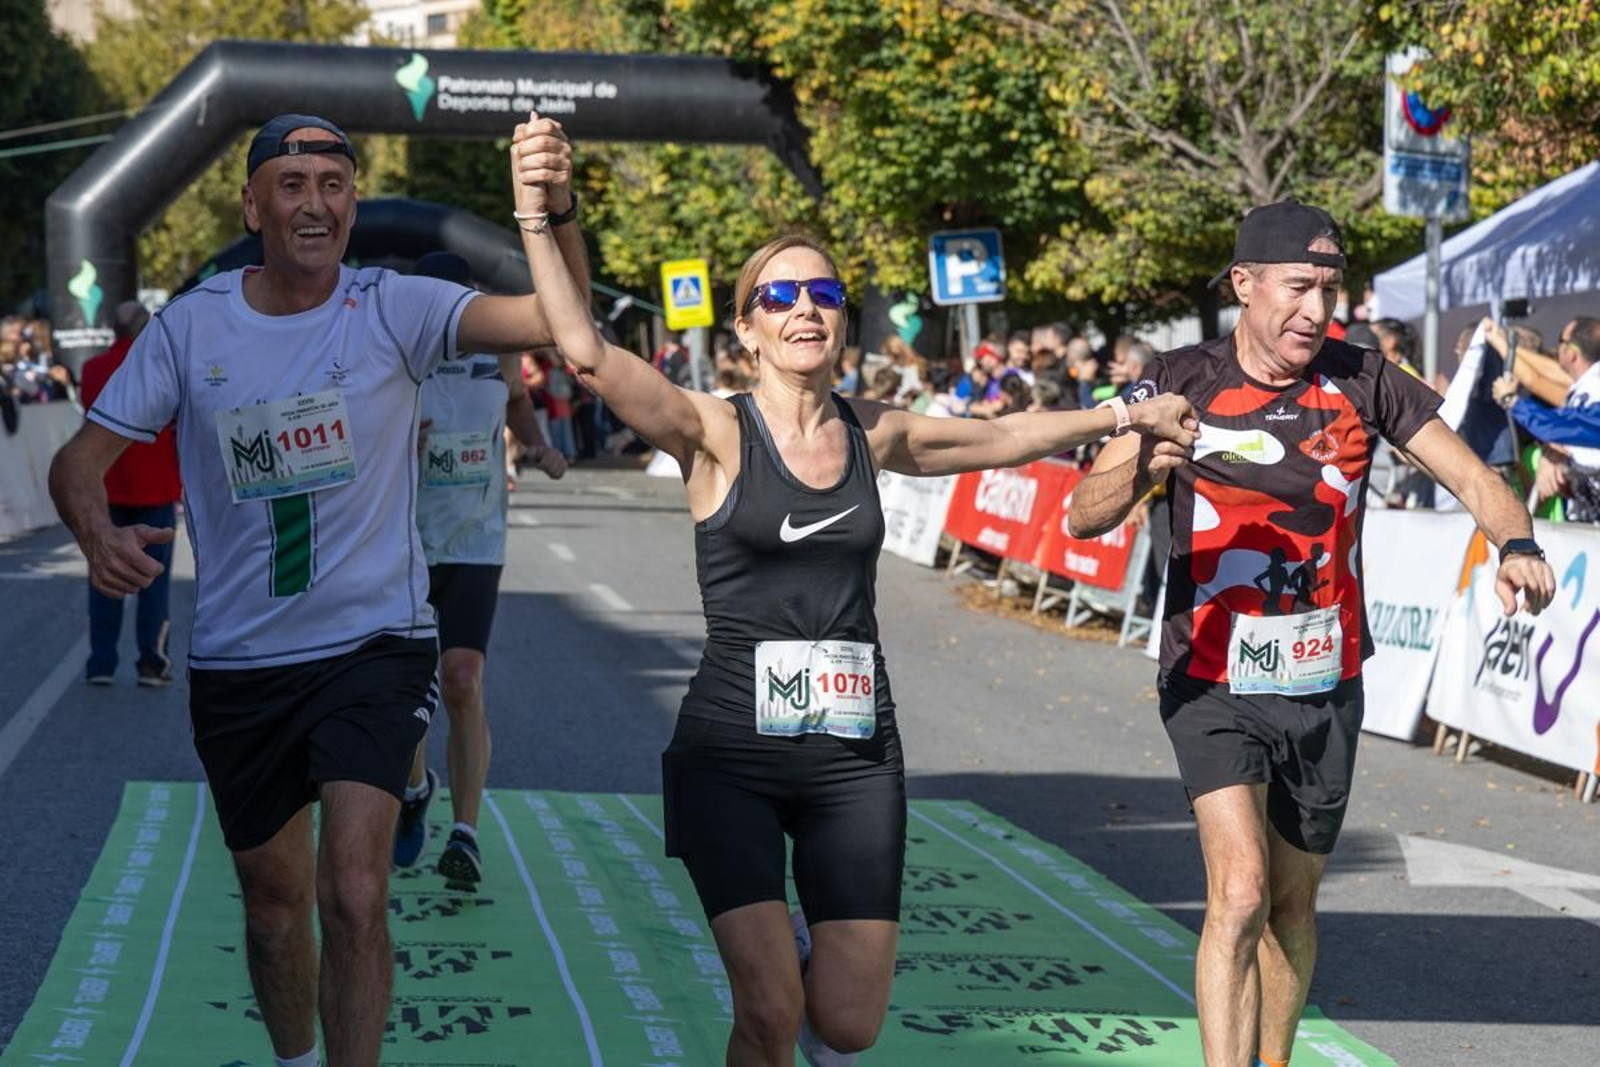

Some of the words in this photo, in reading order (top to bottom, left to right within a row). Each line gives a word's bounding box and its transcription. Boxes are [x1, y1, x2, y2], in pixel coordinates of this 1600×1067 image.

[438, 76, 515, 95] Patronato
[516, 78, 593, 99] Municipal
[594, 82, 617, 98] de
[438, 93, 510, 113] Deportes
[512, 96, 535, 112] de
[946, 238, 987, 295] P
[276, 418, 345, 453] 1011
[461, 448, 488, 464] 862
[1292, 634, 1335, 660] 924
[817, 672, 873, 696] 1078
